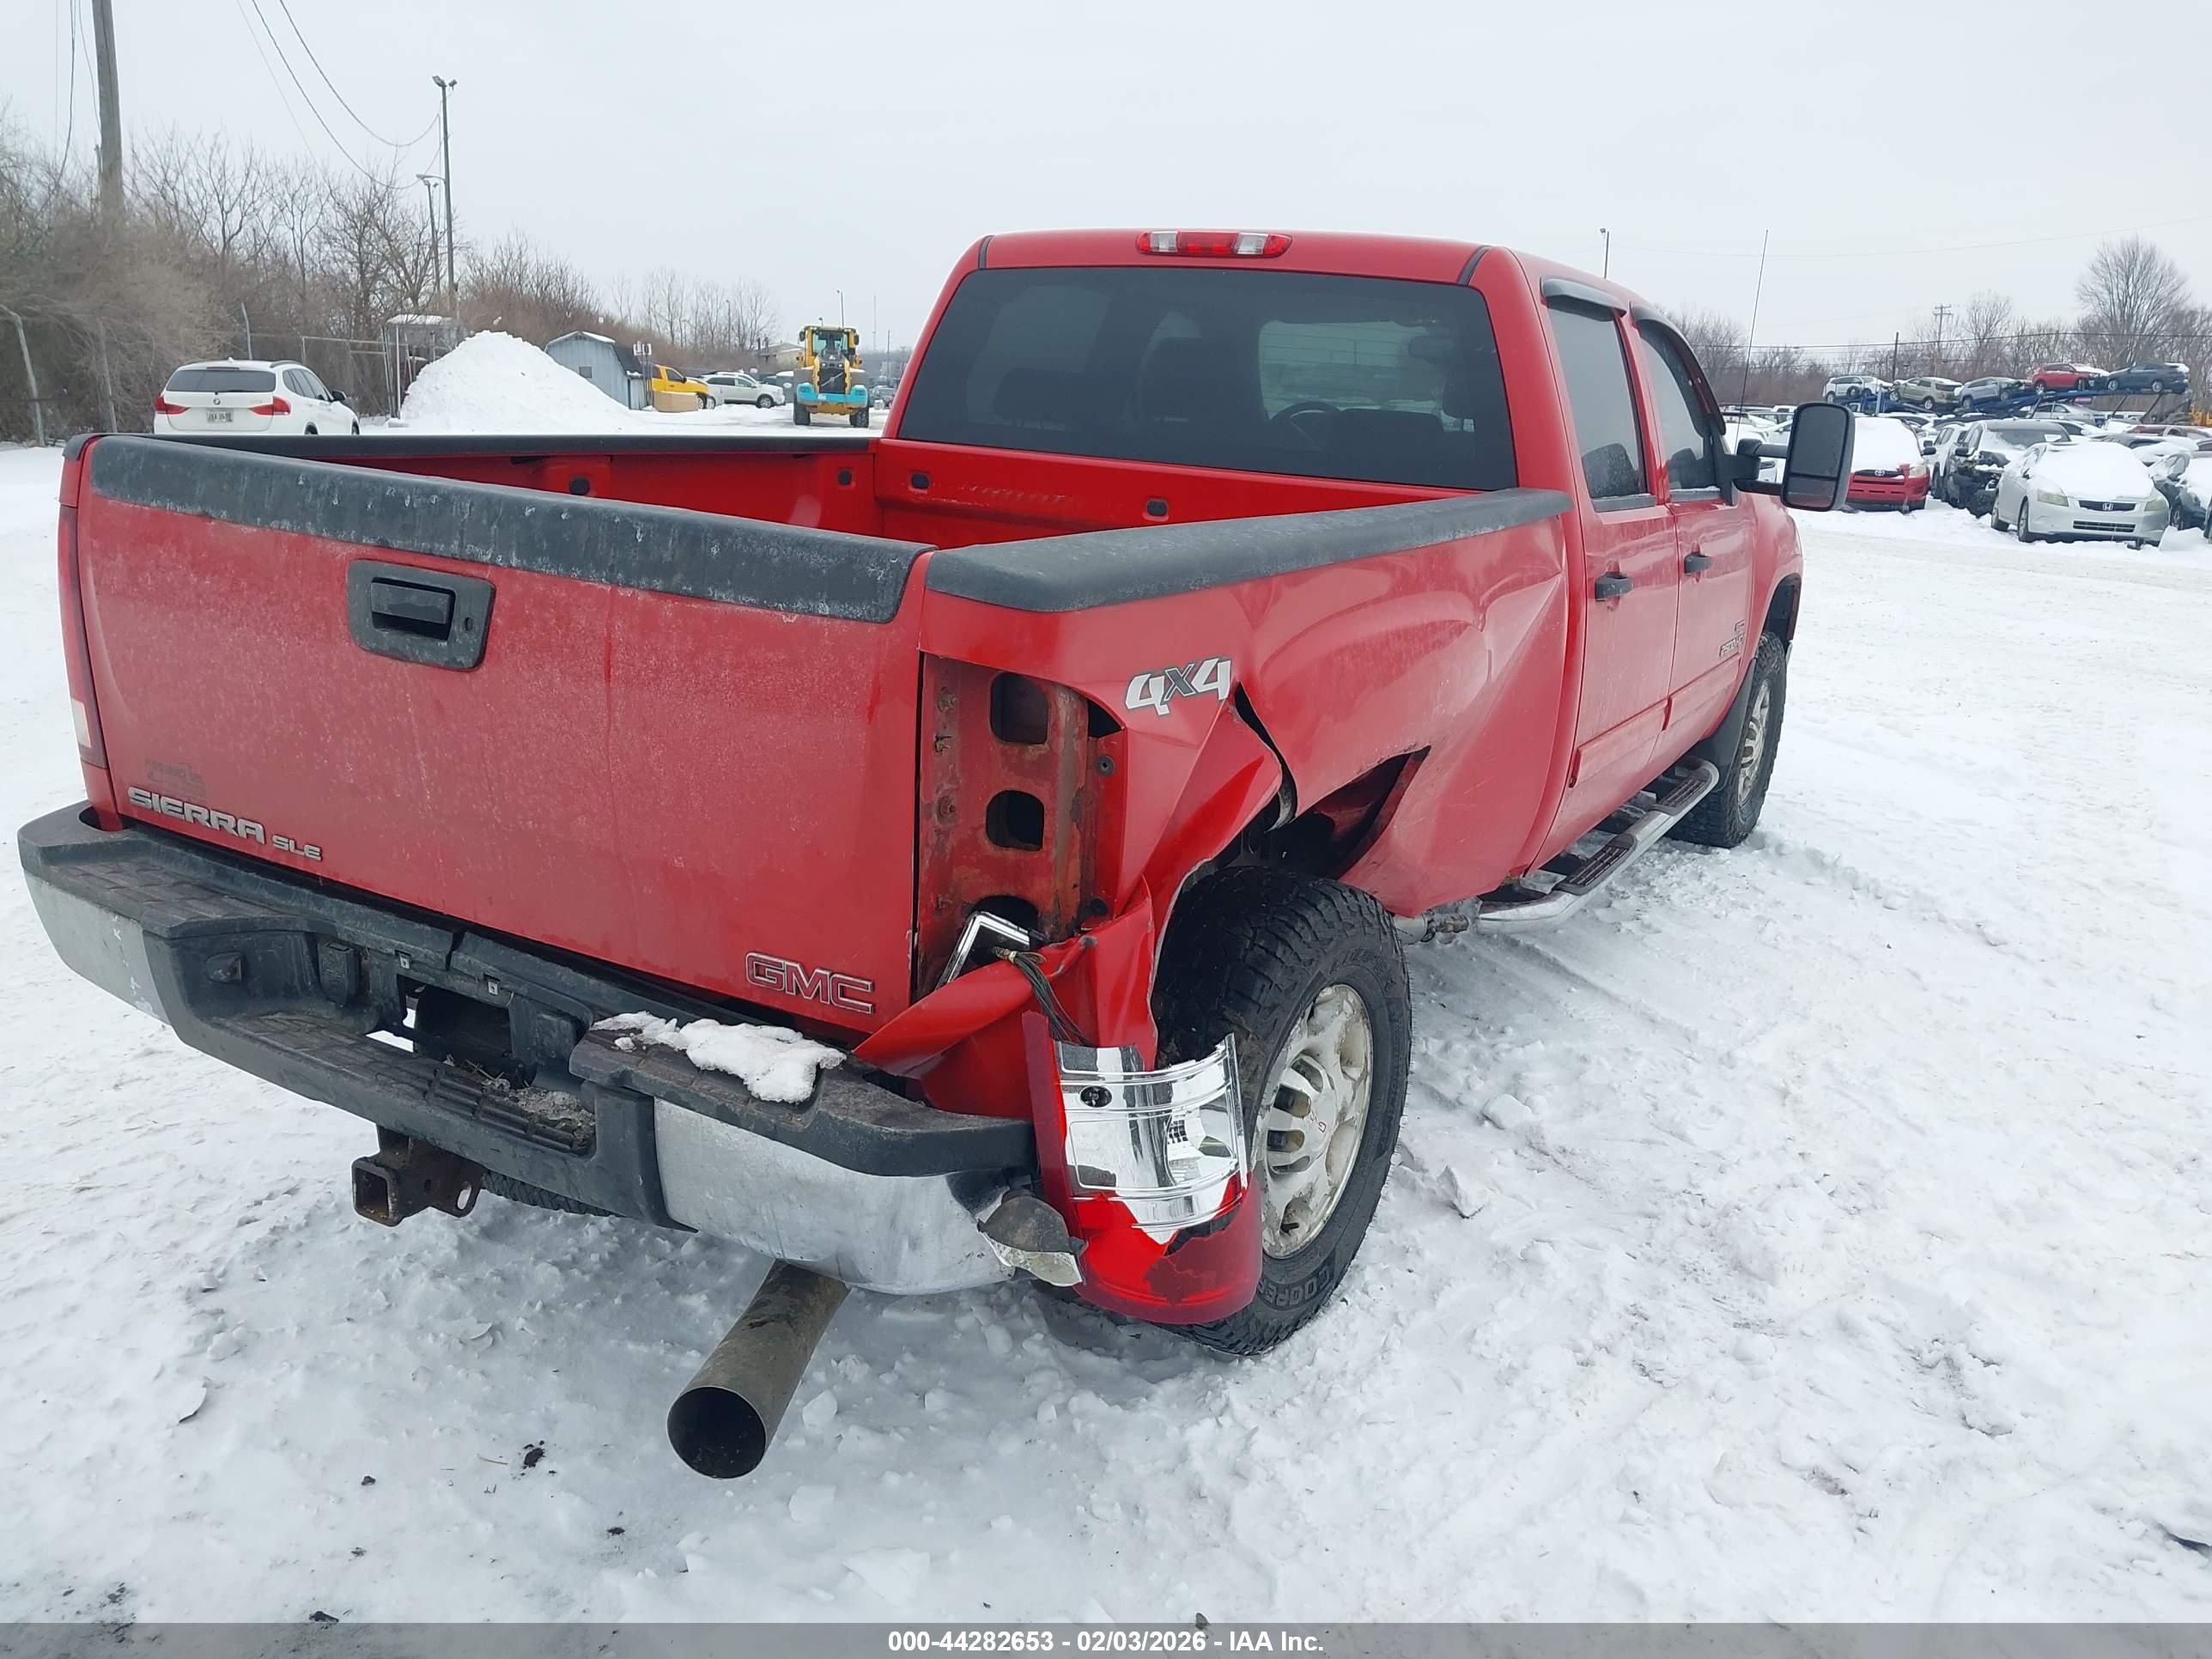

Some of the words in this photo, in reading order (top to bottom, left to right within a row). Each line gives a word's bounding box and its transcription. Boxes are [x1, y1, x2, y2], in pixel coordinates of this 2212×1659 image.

[128, 786, 265, 844] SIERRA
[271, 833, 323, 862] SLE
[745, 951, 874, 1014] GMC
